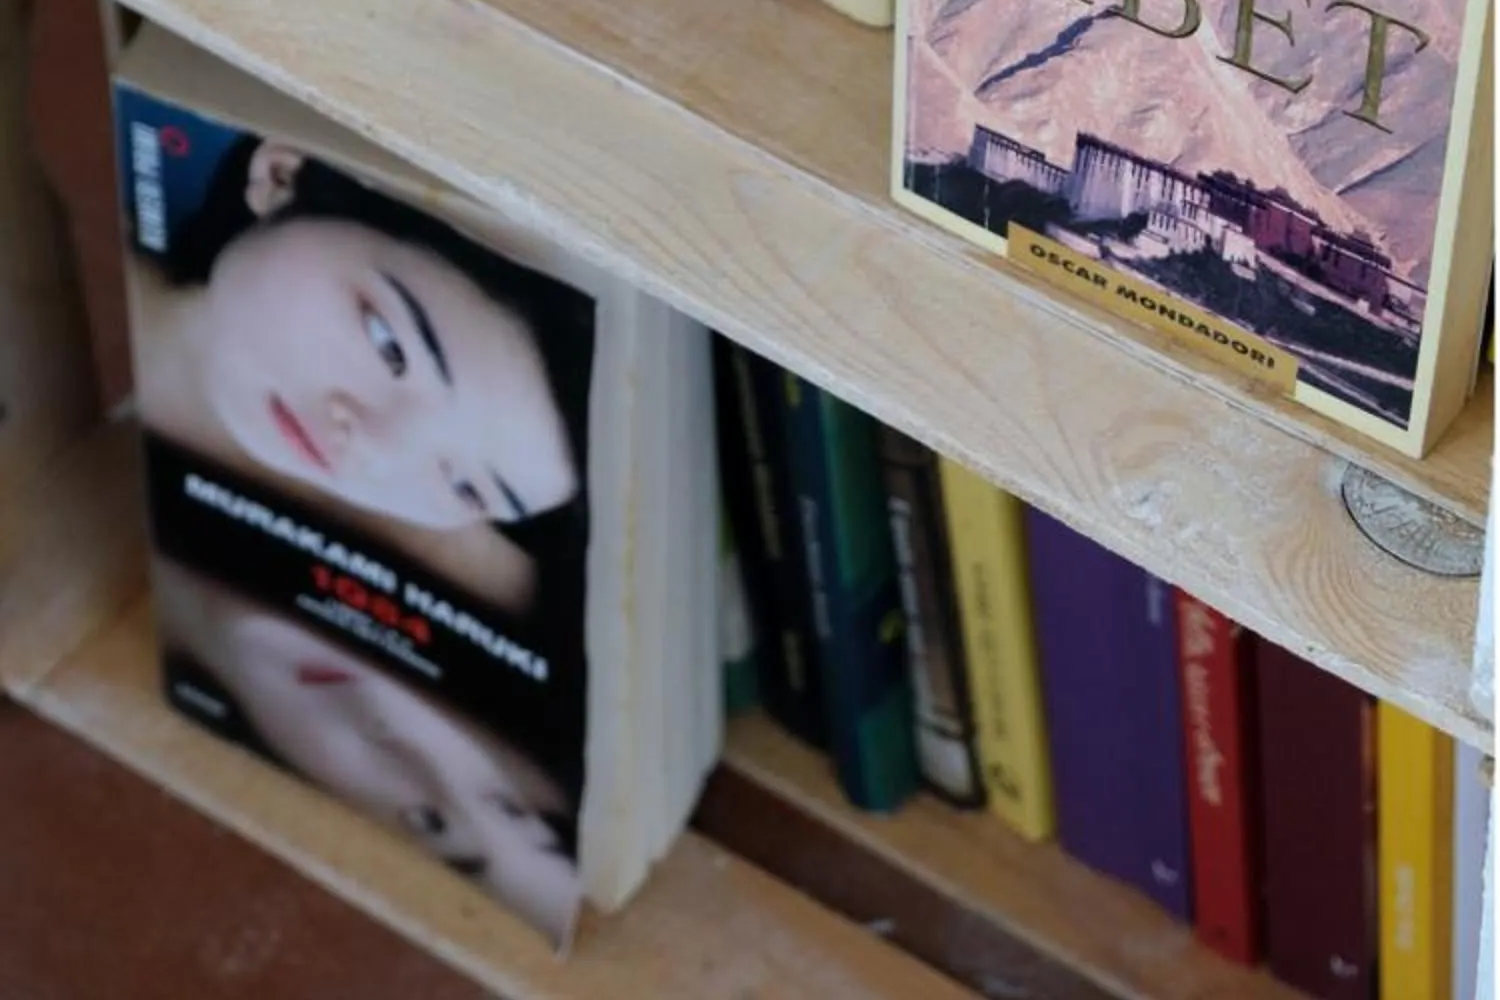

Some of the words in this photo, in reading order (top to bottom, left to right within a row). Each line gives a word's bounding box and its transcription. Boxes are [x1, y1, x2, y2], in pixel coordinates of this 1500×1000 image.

[1029, 243, 1110, 288] OSCAR
[1116, 281, 1275, 369] MONDADORI
[185, 474, 397, 591] MURAKAMI
[403, 585, 547, 680] HARUKI
